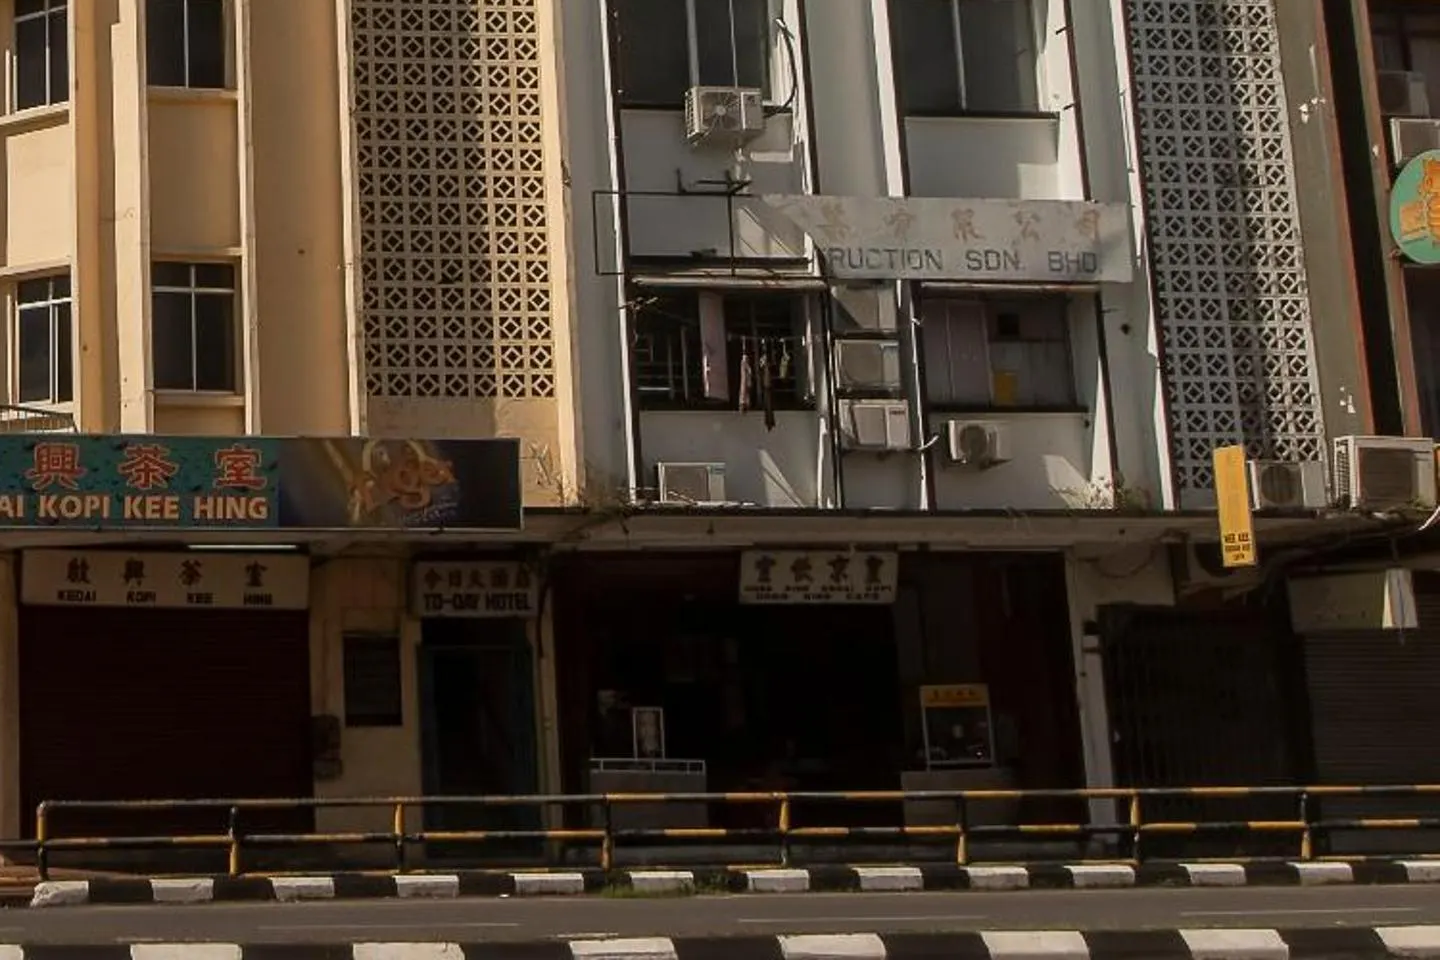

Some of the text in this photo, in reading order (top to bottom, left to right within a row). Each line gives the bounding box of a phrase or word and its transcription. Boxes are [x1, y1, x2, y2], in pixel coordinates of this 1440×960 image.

[823, 247, 942, 271] RUCTION
[38, 494, 110, 520] KOPI
[123, 495, 180, 520] KEE
[193, 495, 269, 520] HING
[57, 589, 96, 602] KEDAI
[125, 591, 156, 604] KOPI
[187, 592, 213, 604] KEE
[423, 592, 533, 610] TO-DAY HOTEL
